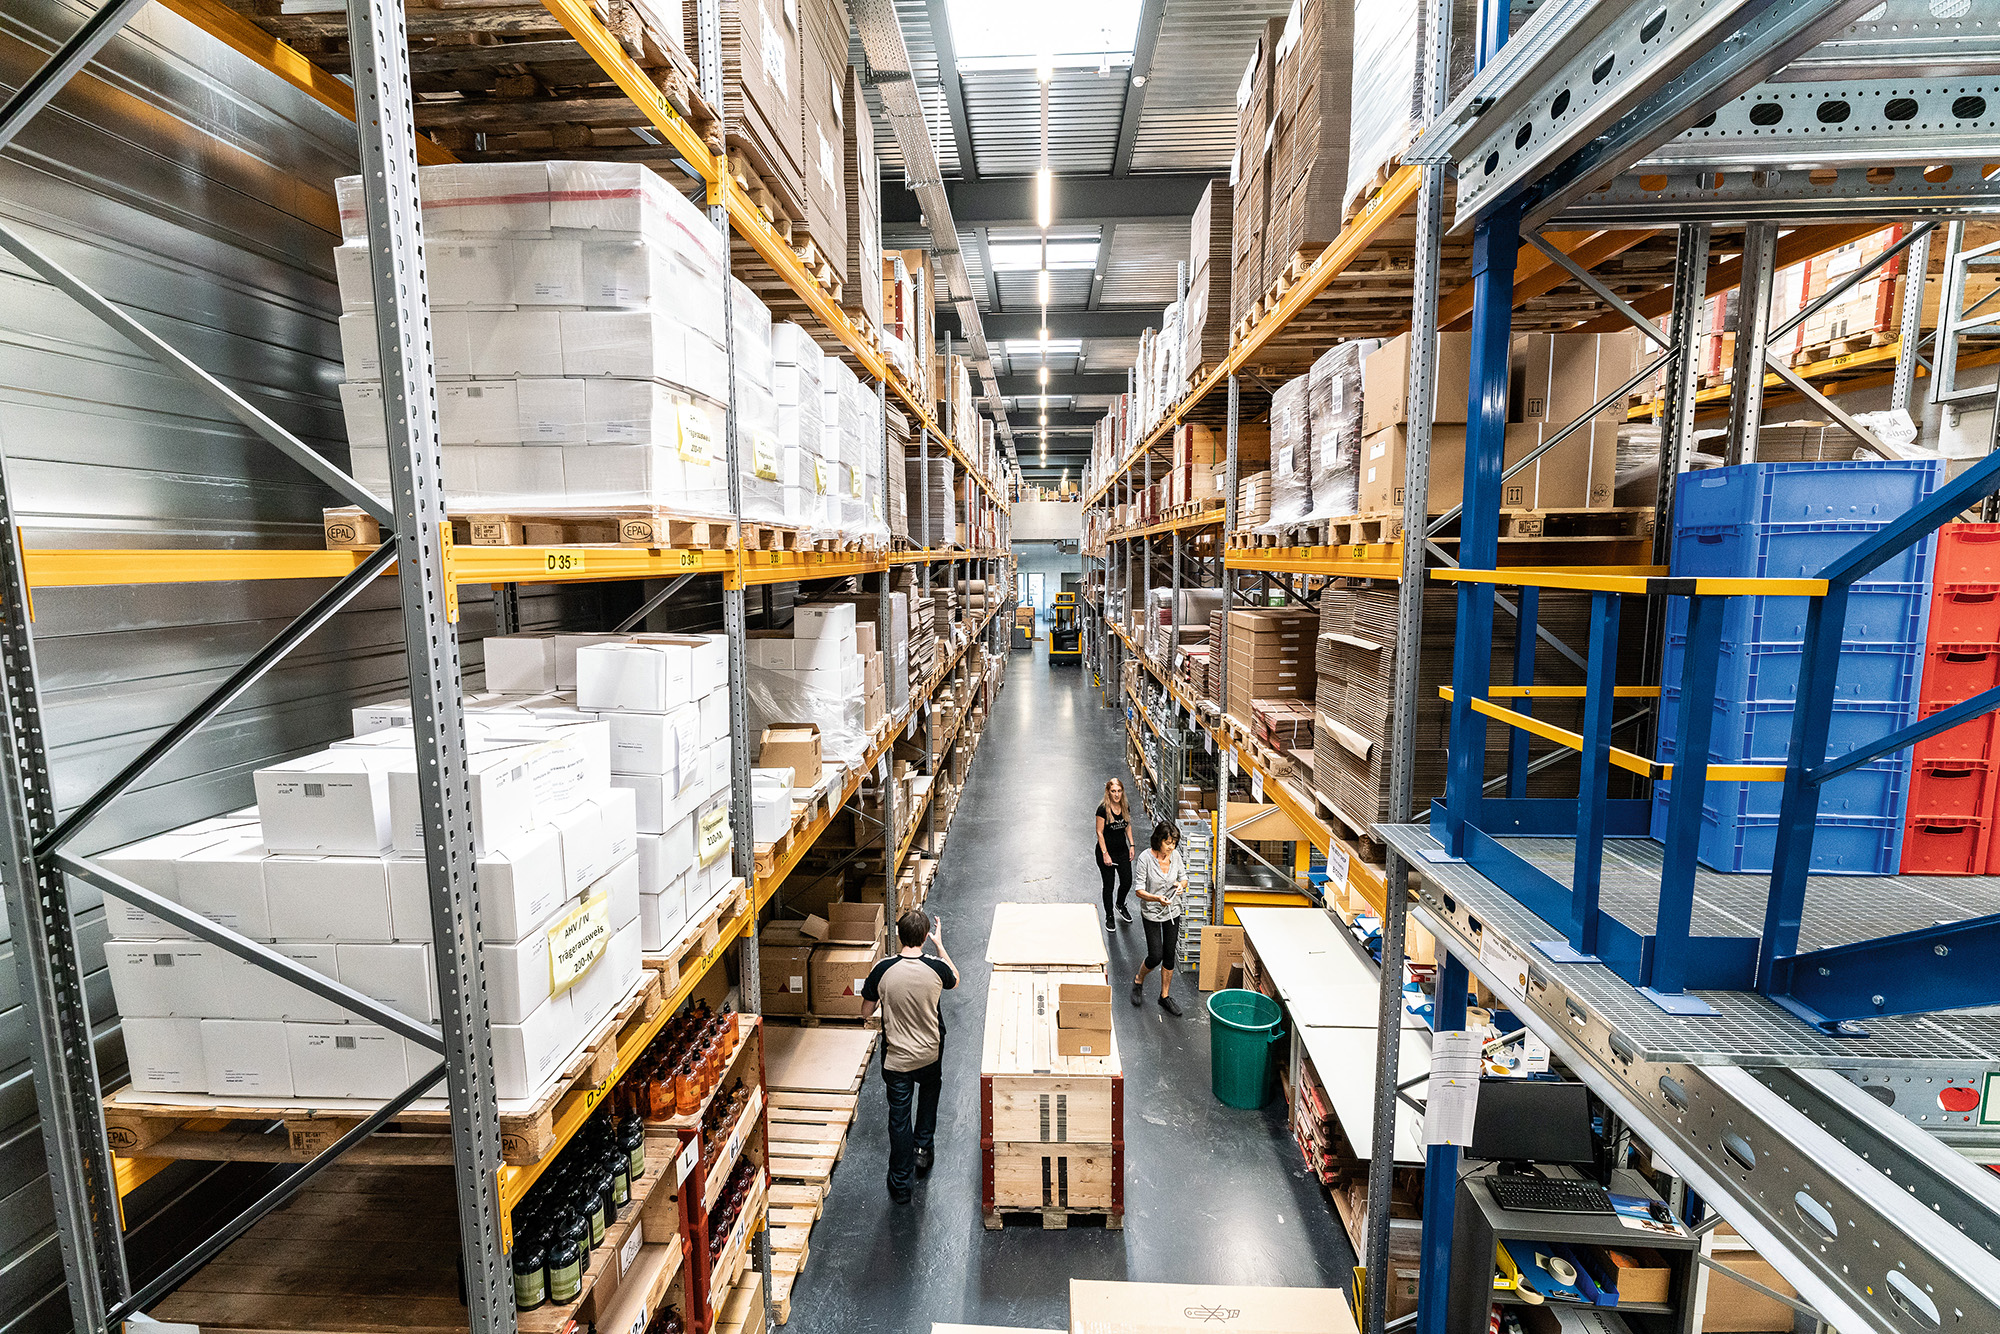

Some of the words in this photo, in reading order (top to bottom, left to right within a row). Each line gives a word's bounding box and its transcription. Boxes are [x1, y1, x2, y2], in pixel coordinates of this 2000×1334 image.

[330, 529, 351, 540] EPAL
[626, 526, 648, 536] EPAL
[548, 555, 556, 570] D
[558, 555, 571, 570] 35
[680, 556, 686, 566] D
[686, 555, 695, 566] 34
[564, 924, 579, 940] AHV
[557, 924, 605, 965] Trägerausweis
[573, 950, 595, 973] 200-M
[587, 1091, 594, 1109] D
[107, 1131, 132, 1144] EPAL
[684, 1152, 693, 1170] L
